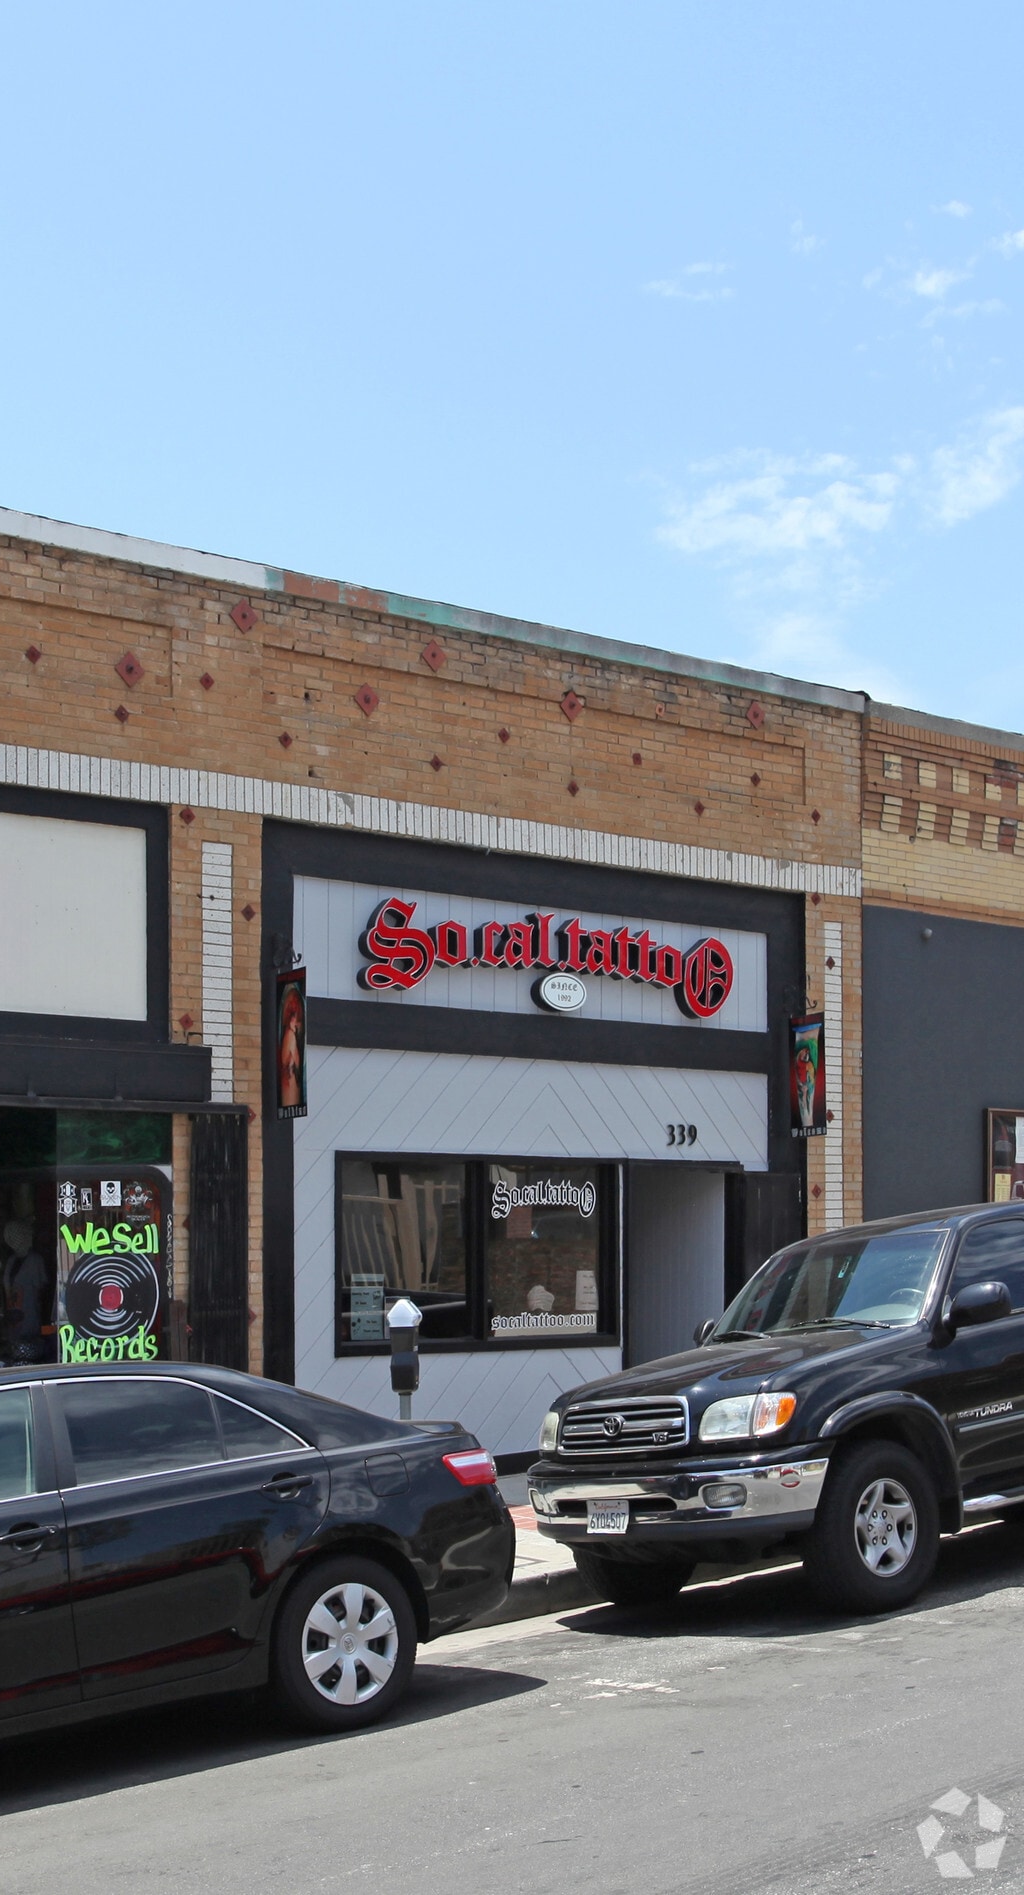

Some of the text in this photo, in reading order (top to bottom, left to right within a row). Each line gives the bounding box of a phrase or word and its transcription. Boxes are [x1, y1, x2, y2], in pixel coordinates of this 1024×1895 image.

[551, 981, 578, 992] SINCE
[666, 1123, 698, 1147] 339
[59, 1221, 160, 1255] We Sell
[491, 1312, 596, 1331] socaltattoo.com
[59, 1324, 159, 1364] Records
[975, 1401, 1013, 1418] TUNDRA
